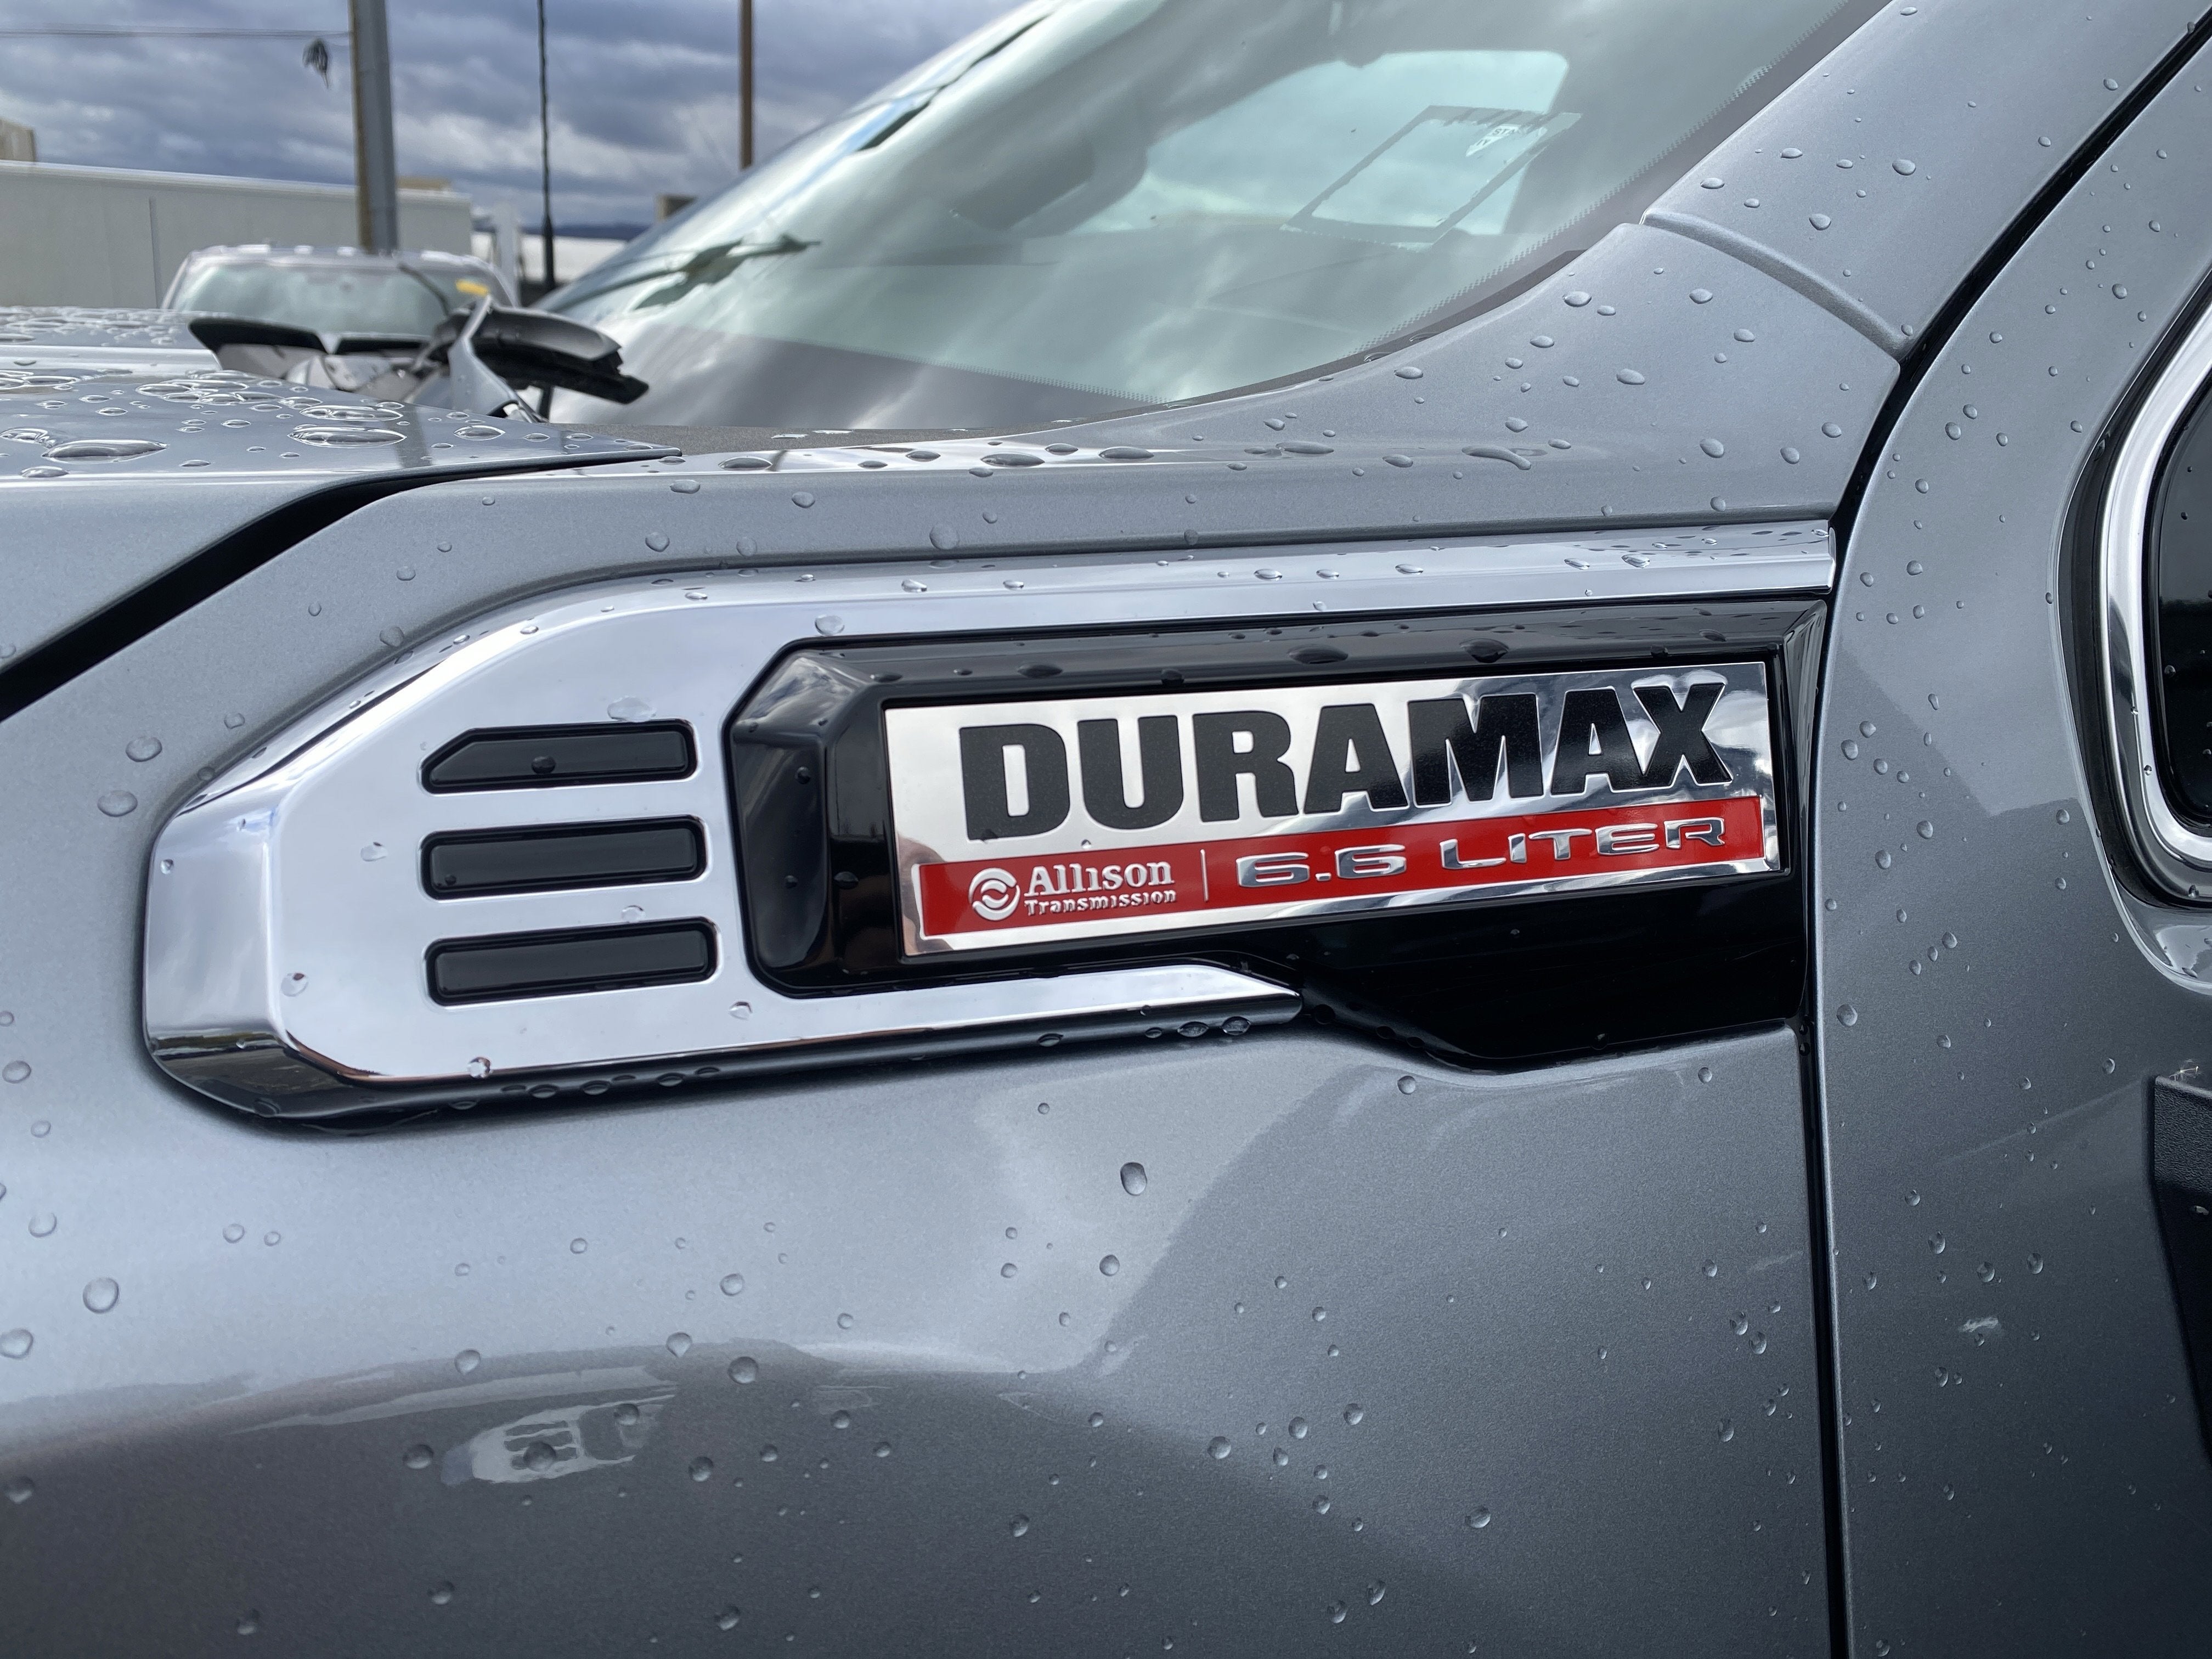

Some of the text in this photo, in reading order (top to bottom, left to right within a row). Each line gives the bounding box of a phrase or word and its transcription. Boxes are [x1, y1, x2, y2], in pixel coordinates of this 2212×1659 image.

[960, 684, 1732, 840] DURAMAX
[1024, 861, 1175, 897] Allison
[1235, 817, 1726, 888] 6.6 LITER
[1024, 890, 1176, 916] Transmission
